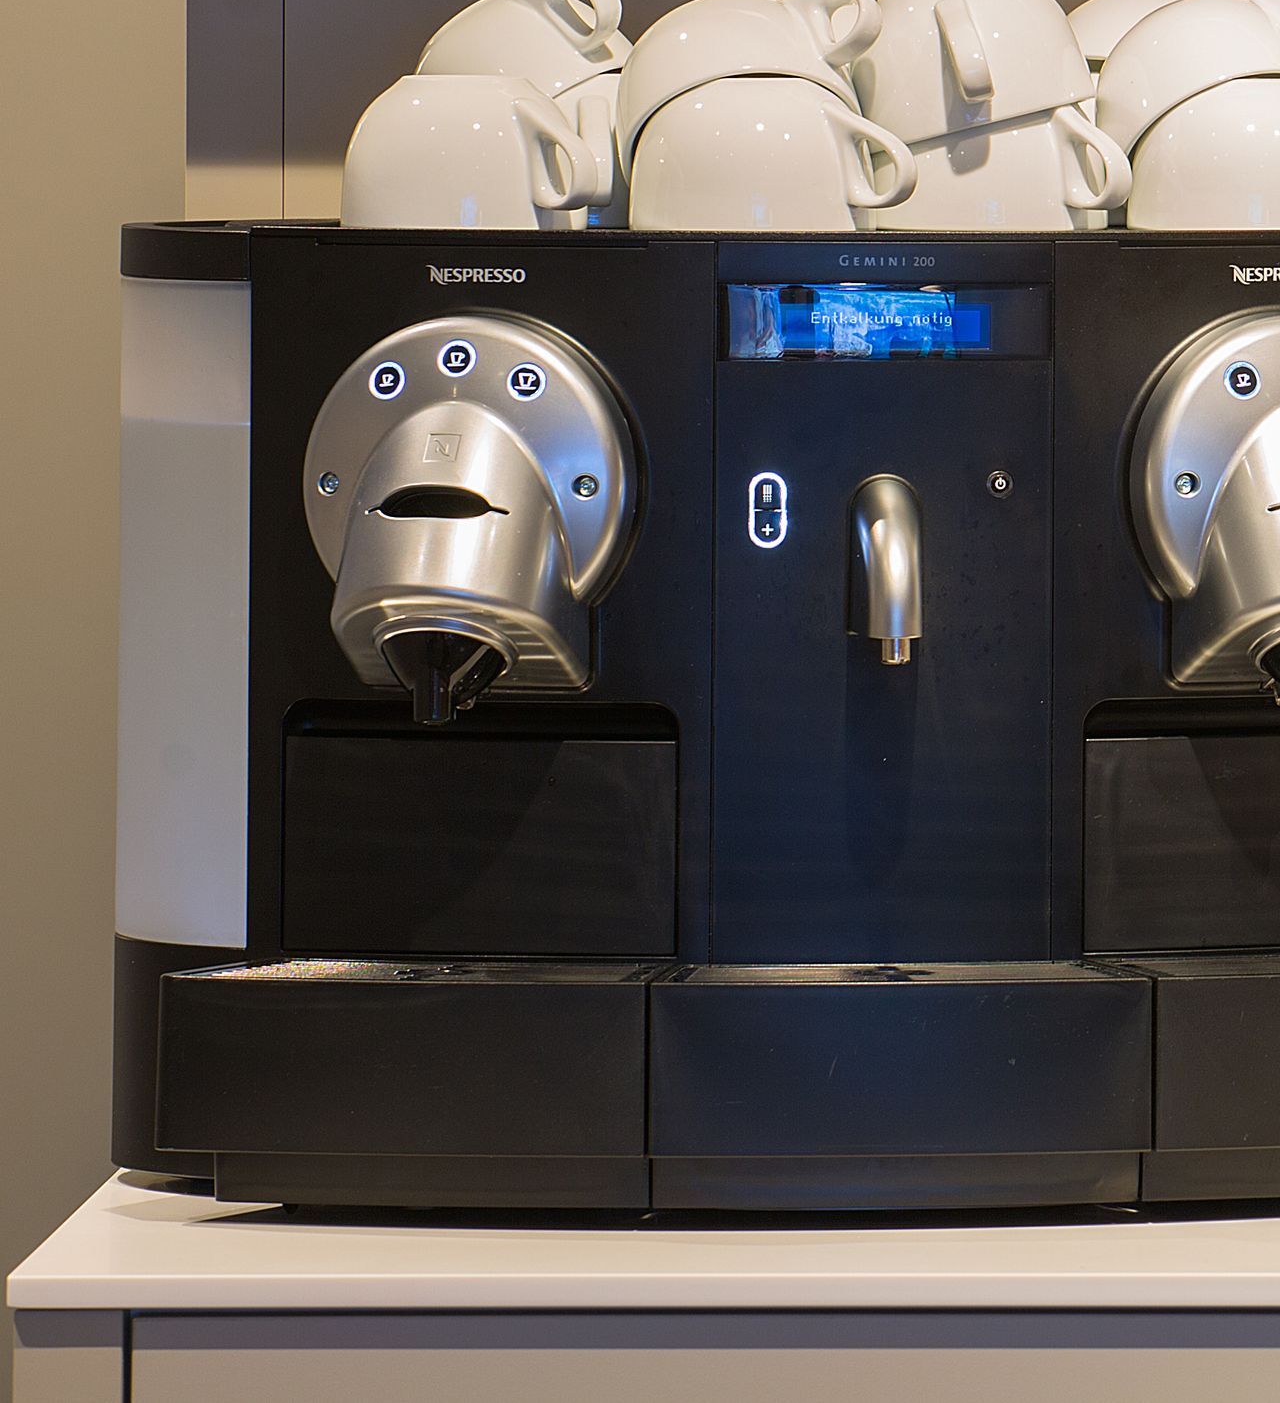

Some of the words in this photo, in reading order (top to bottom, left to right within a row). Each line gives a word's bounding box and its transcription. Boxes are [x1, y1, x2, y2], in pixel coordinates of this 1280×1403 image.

[839, 254, 906, 267] GEMINI
[912, 256, 935, 267] 200
[425, 264, 526, 286] NESPRESSO
[810, 311, 903, 327] Entkalkung
[912, 311, 953, 327] nötig
